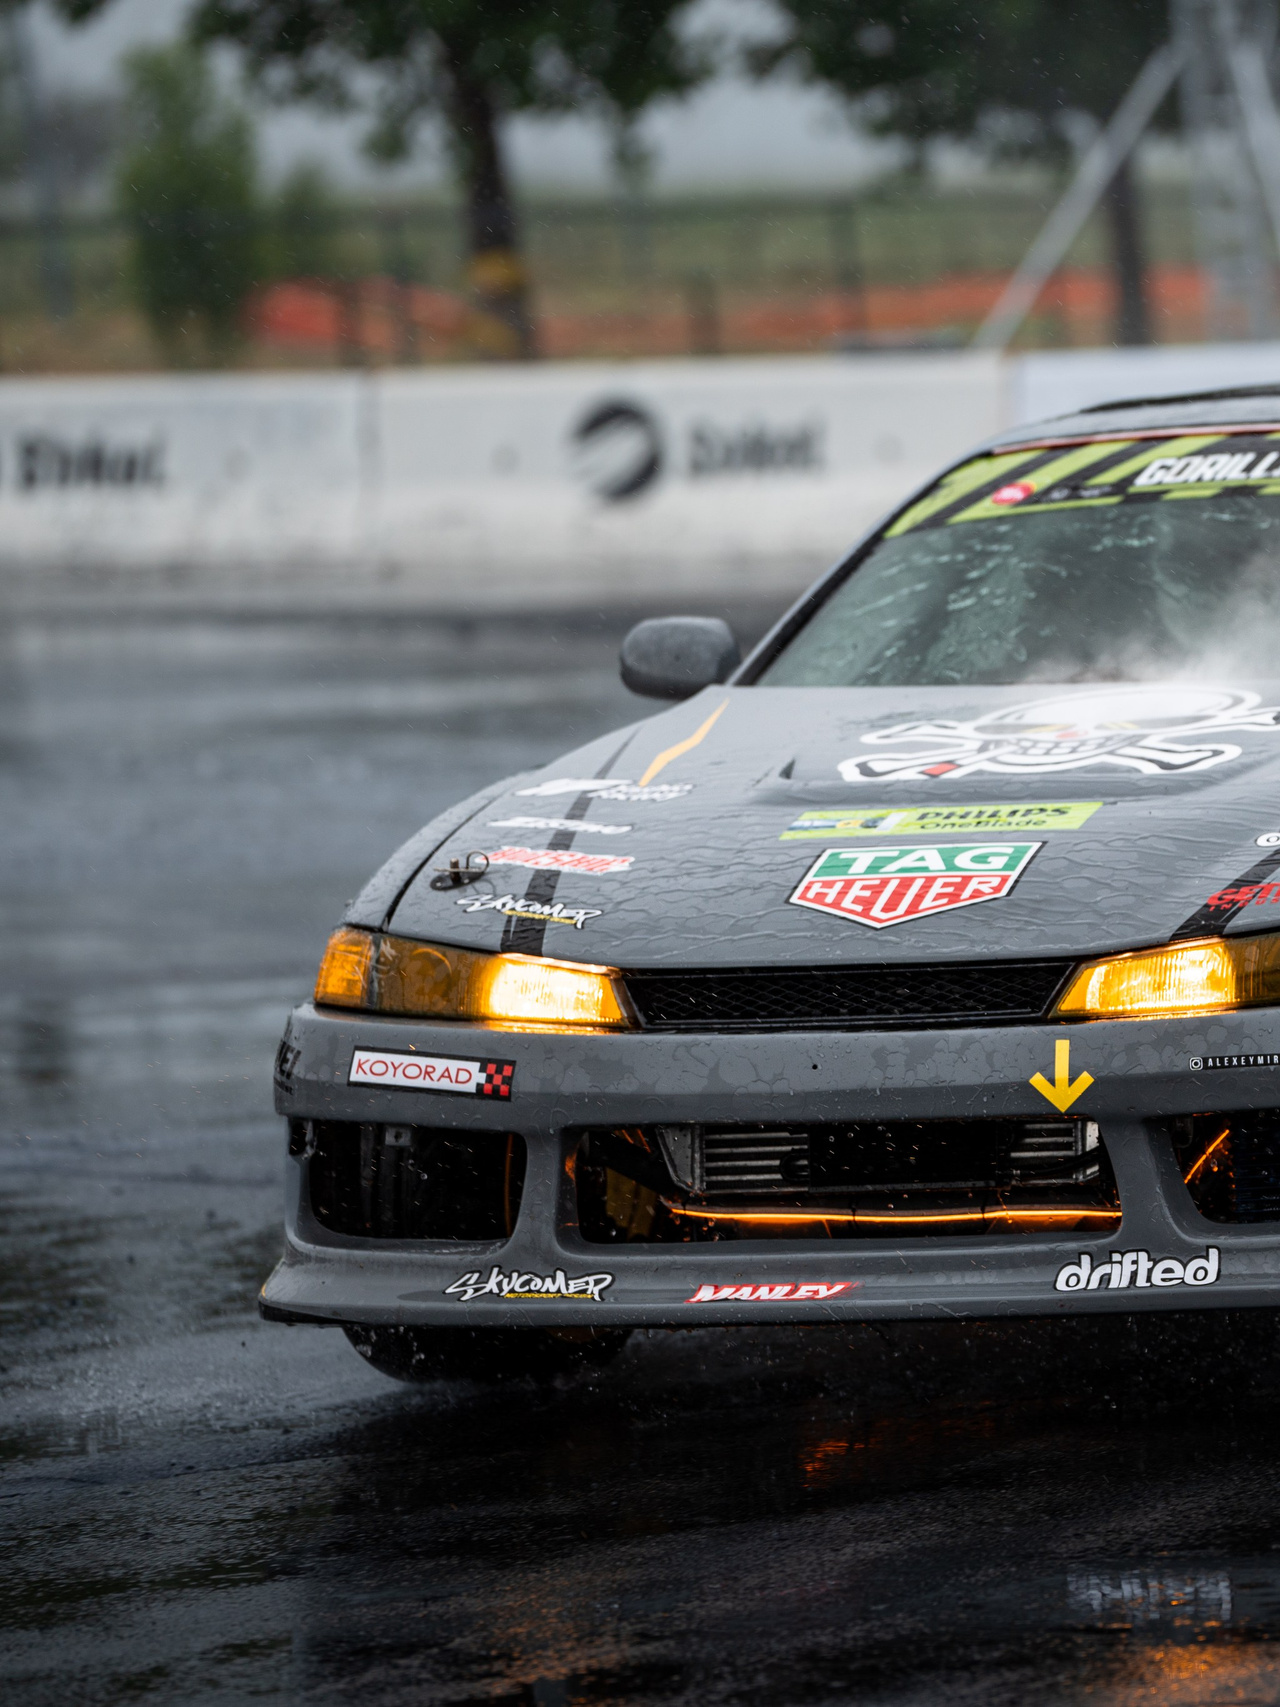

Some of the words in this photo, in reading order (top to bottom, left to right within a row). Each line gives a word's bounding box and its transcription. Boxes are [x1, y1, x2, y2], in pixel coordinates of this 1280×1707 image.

[915, 806, 1072, 821] PHILIPS
[919, 818, 1047, 831] OneBlade
[838, 846, 1015, 876] TAG
[805, 876, 1002, 920] HEUER
[355, 1058, 473, 1085] KOYORAD
[1056, 1248, 1220, 1292] drifted
[690, 1284, 847, 1302] MANLEY
